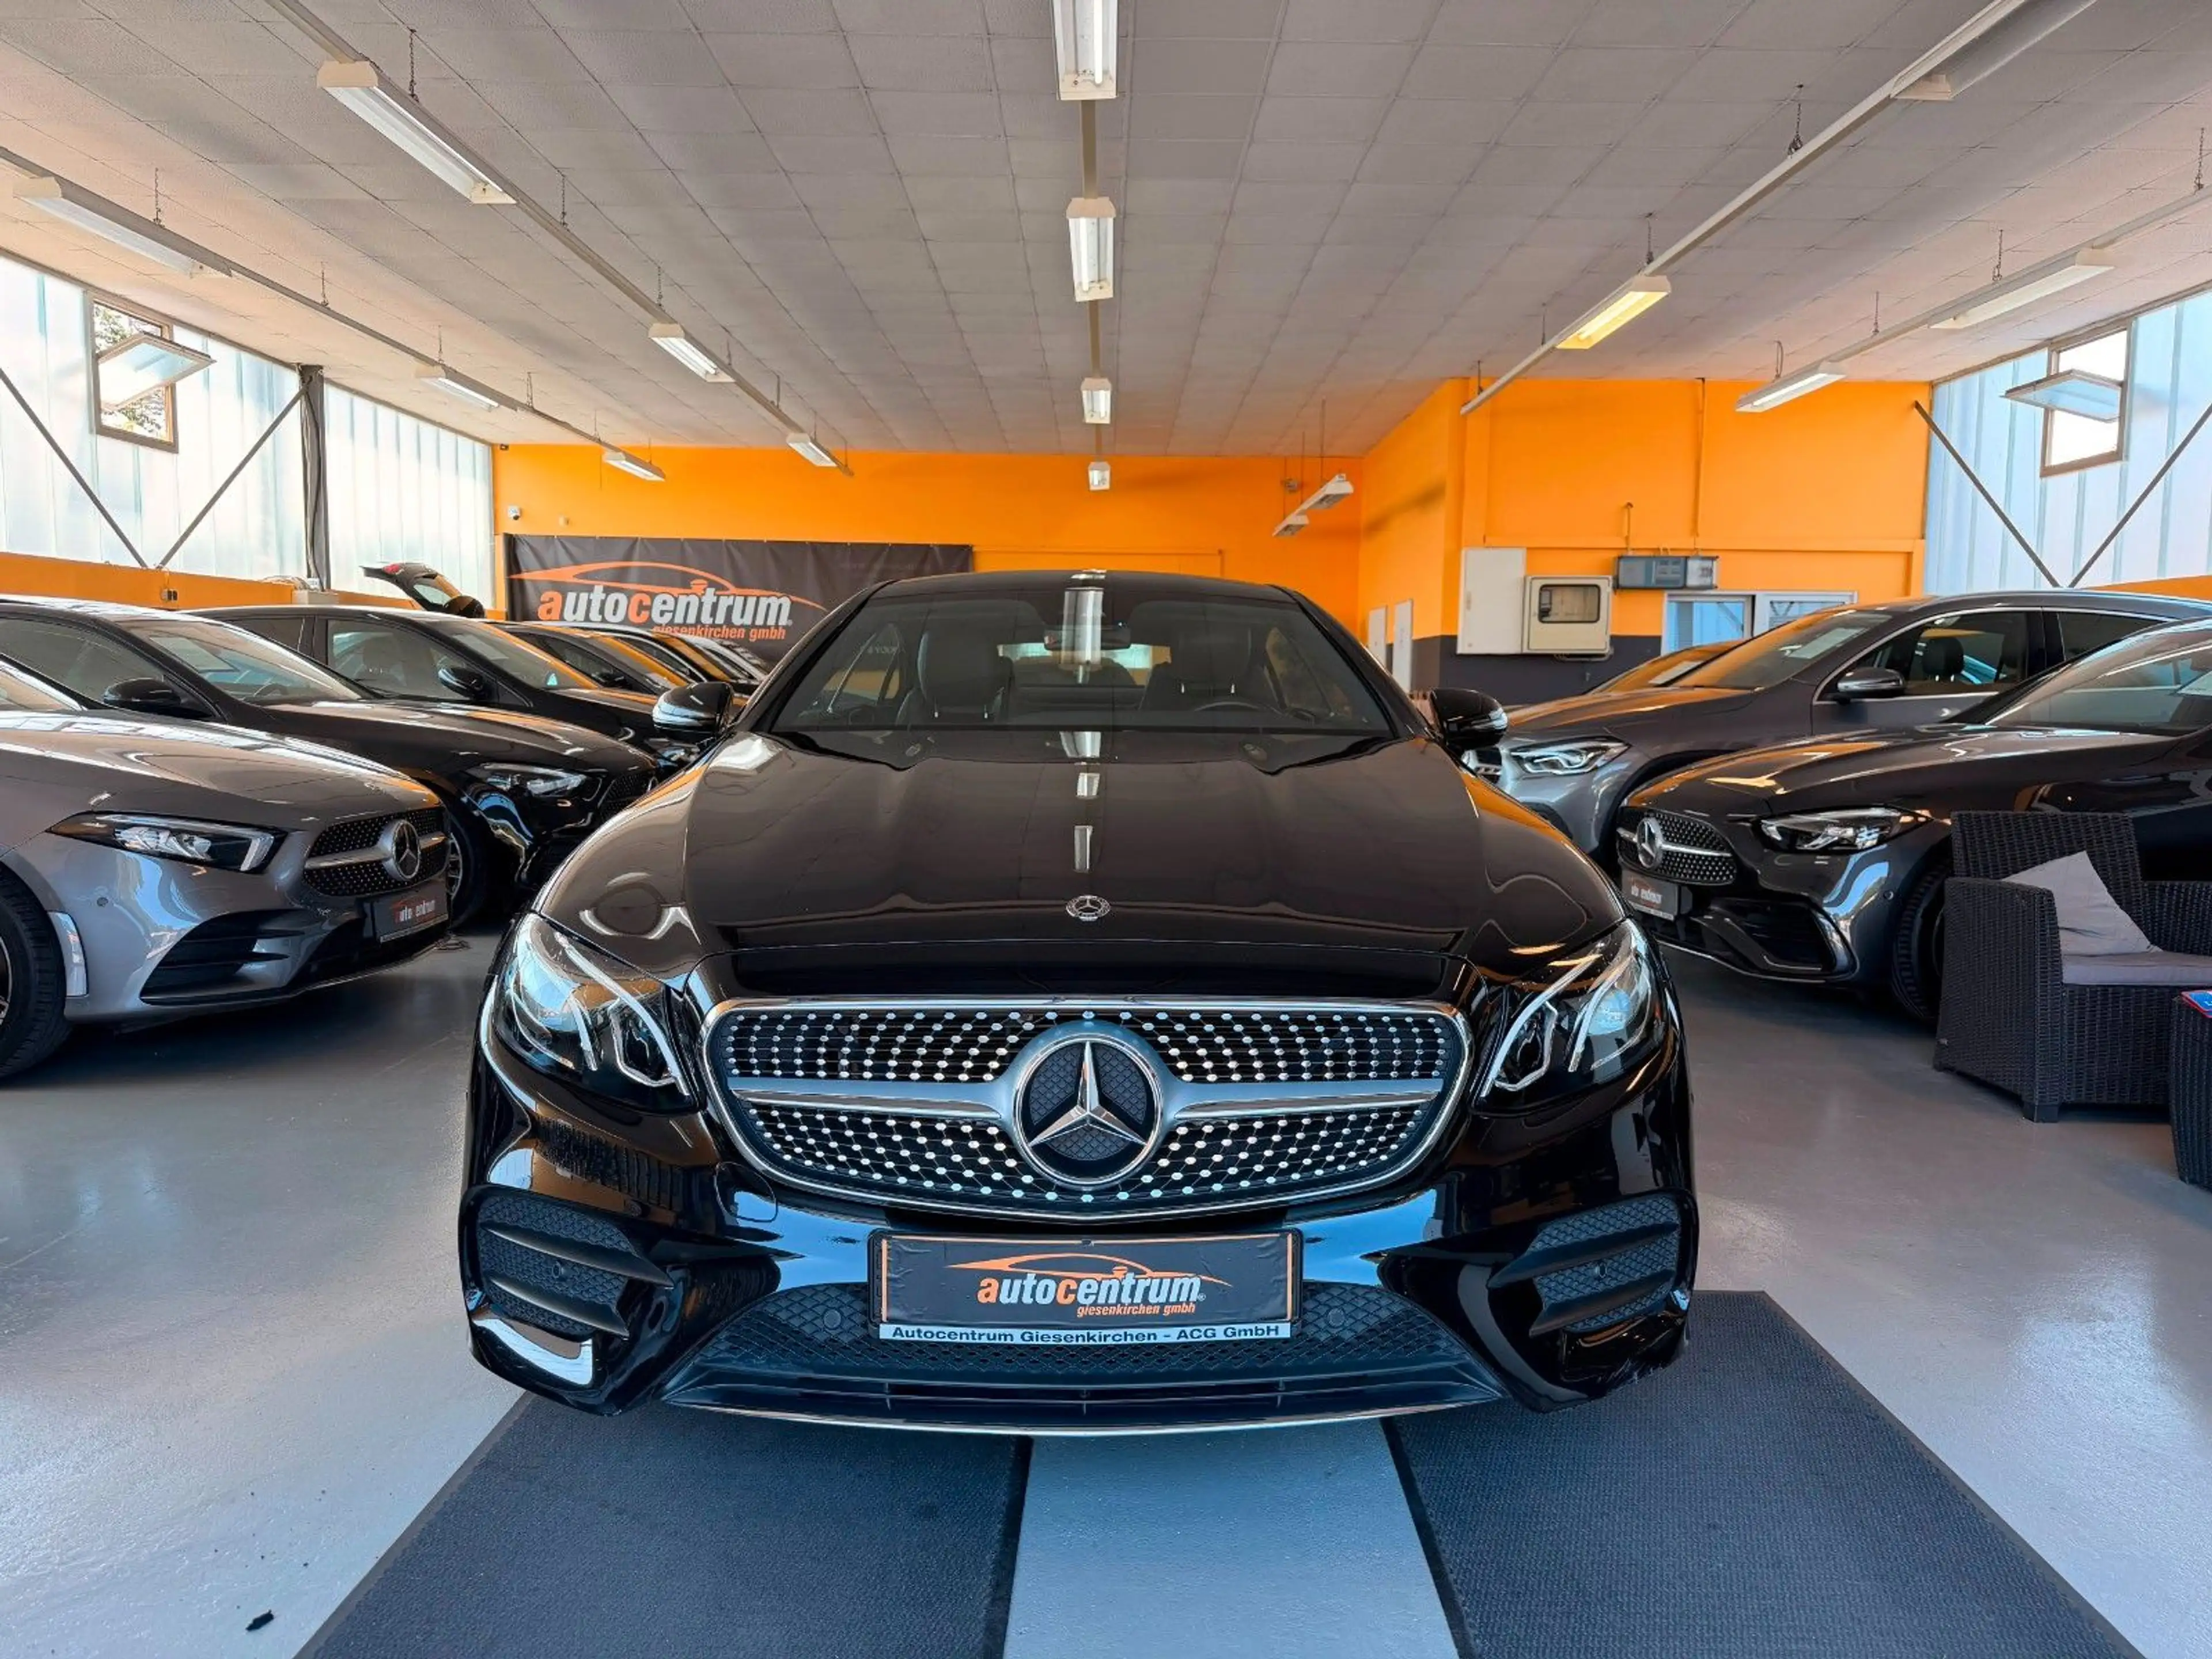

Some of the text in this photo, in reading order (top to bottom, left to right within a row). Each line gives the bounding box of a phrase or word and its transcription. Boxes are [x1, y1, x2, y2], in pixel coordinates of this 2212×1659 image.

[537, 585, 790, 626] autocentrum
[749, 627, 786, 642] gmbh
[978, 1271, 1200, 1305] autocentrum
[1077, 1304, 1195, 1317] giesenkirchen gmbh
[892, 1327, 1014, 1342] Autocentrum
[1020, 1330, 1157, 1343] Giesenkirchen
[1176, 1328, 1217, 1340] ACG
[1224, 1325, 1279, 1338] GmbH
